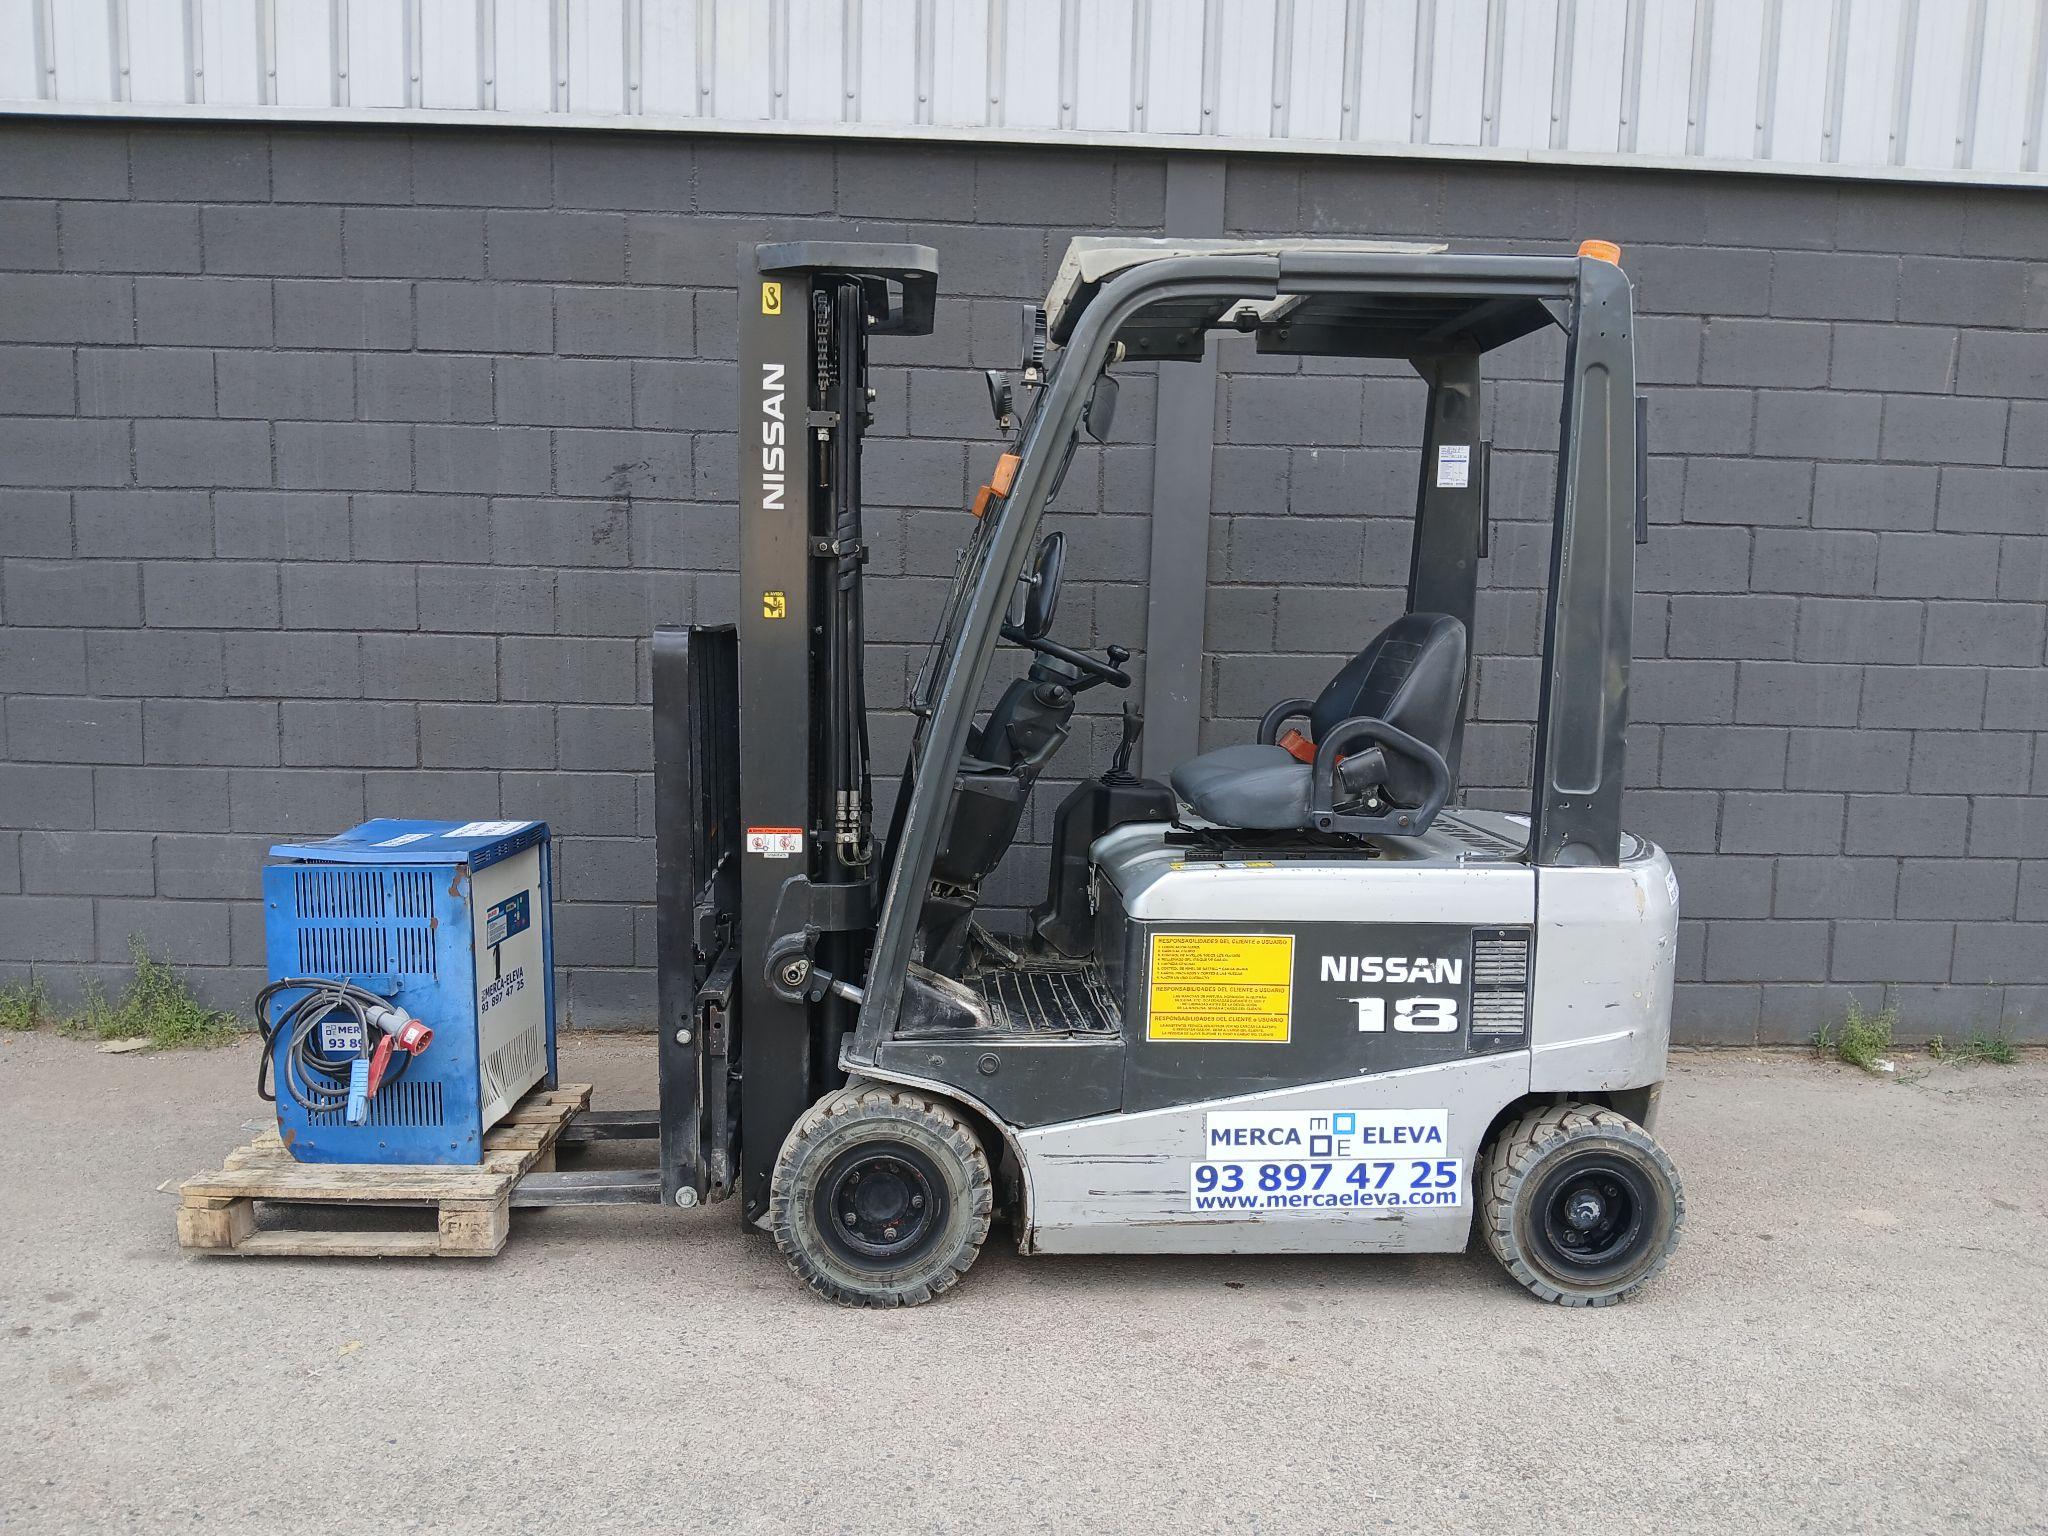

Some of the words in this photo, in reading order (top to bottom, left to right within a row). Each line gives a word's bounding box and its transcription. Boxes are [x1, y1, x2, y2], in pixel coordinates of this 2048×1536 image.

[762, 363, 785, 510] NISSAN
[1320, 955, 1463, 985] NISSAN
[481, 1001, 489, 1015] 93
[491, 991, 503, 1007] 897
[505, 984, 514, 997] 47
[516, 978, 525, 992] 25
[338, 1026, 361, 1034] MER
[1346, 997, 1459, 1033] 18
[328, 1038, 346, 1049] 93
[1211, 1128, 1302, 1146] MERCA
[1363, 1126, 1442, 1145] ELEVA
[1195, 1164, 1244, 1193] 93
[1258, 1163, 1333, 1192] 897
[1346, 1162, 1395, 1190] 47
[1410, 1161, 1457, 1189] 25
[1195, 1190, 1457, 1209] www.mercaeleva.com
